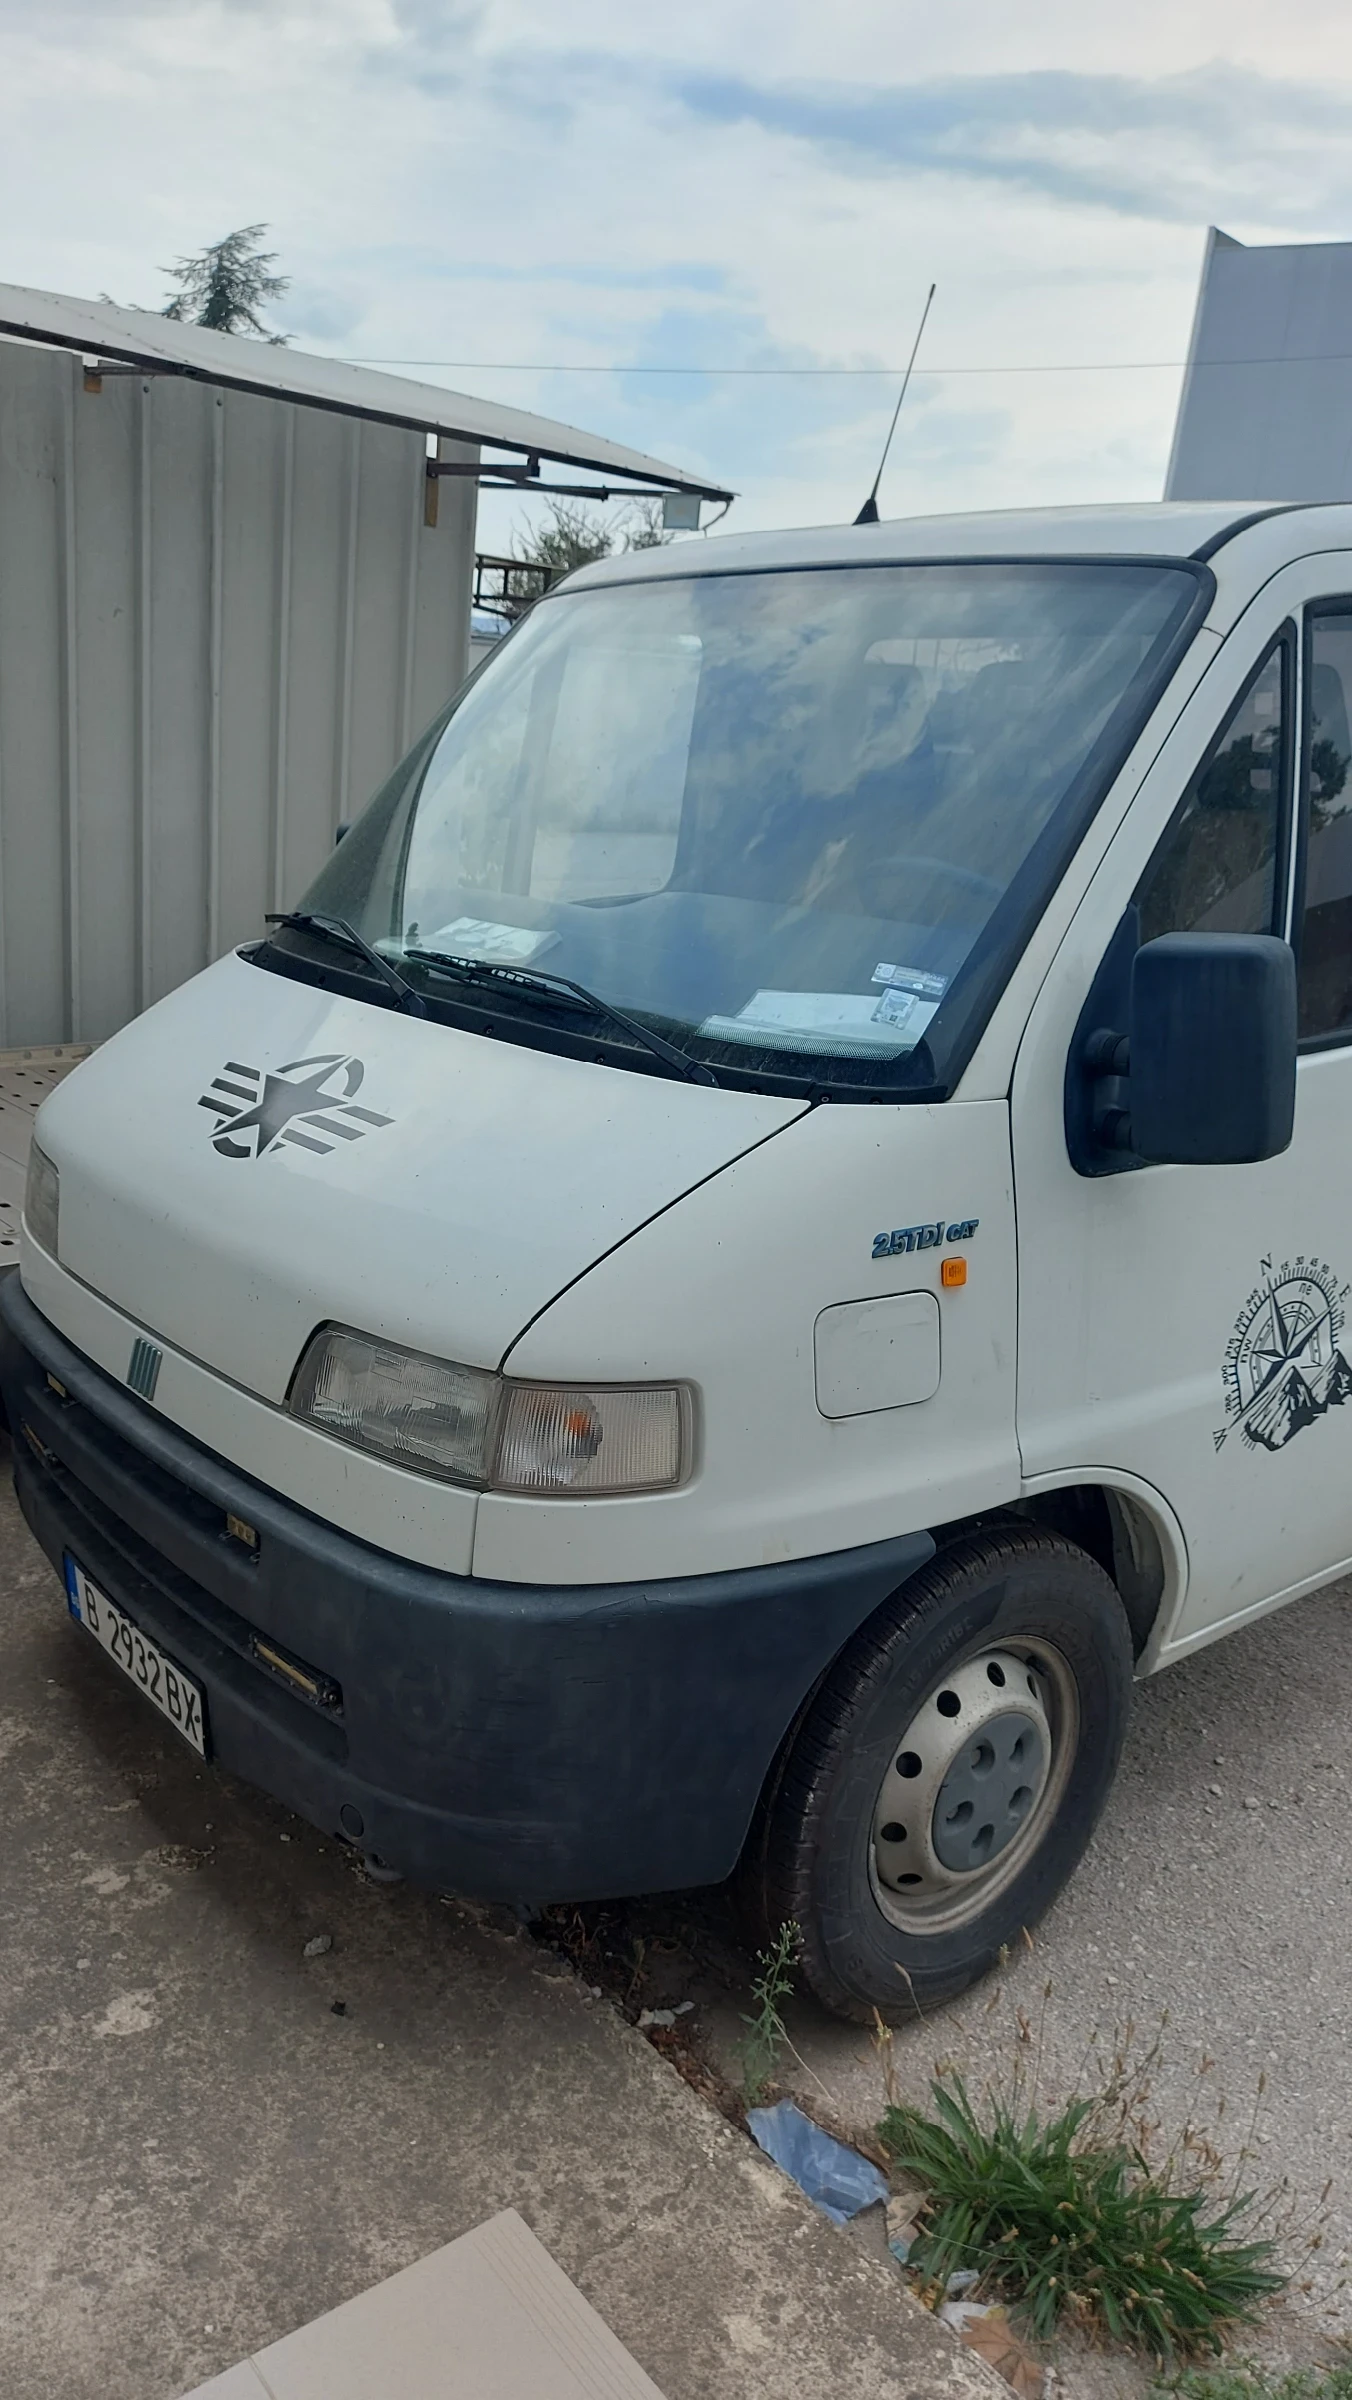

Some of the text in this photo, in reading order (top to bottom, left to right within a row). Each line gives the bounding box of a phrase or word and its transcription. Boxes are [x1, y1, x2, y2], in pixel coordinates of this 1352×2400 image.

[946, 1219, 979, 1242] CAT
[1260, 1252, 1272, 1277] N
[84, 1583, 99, 1633] B
